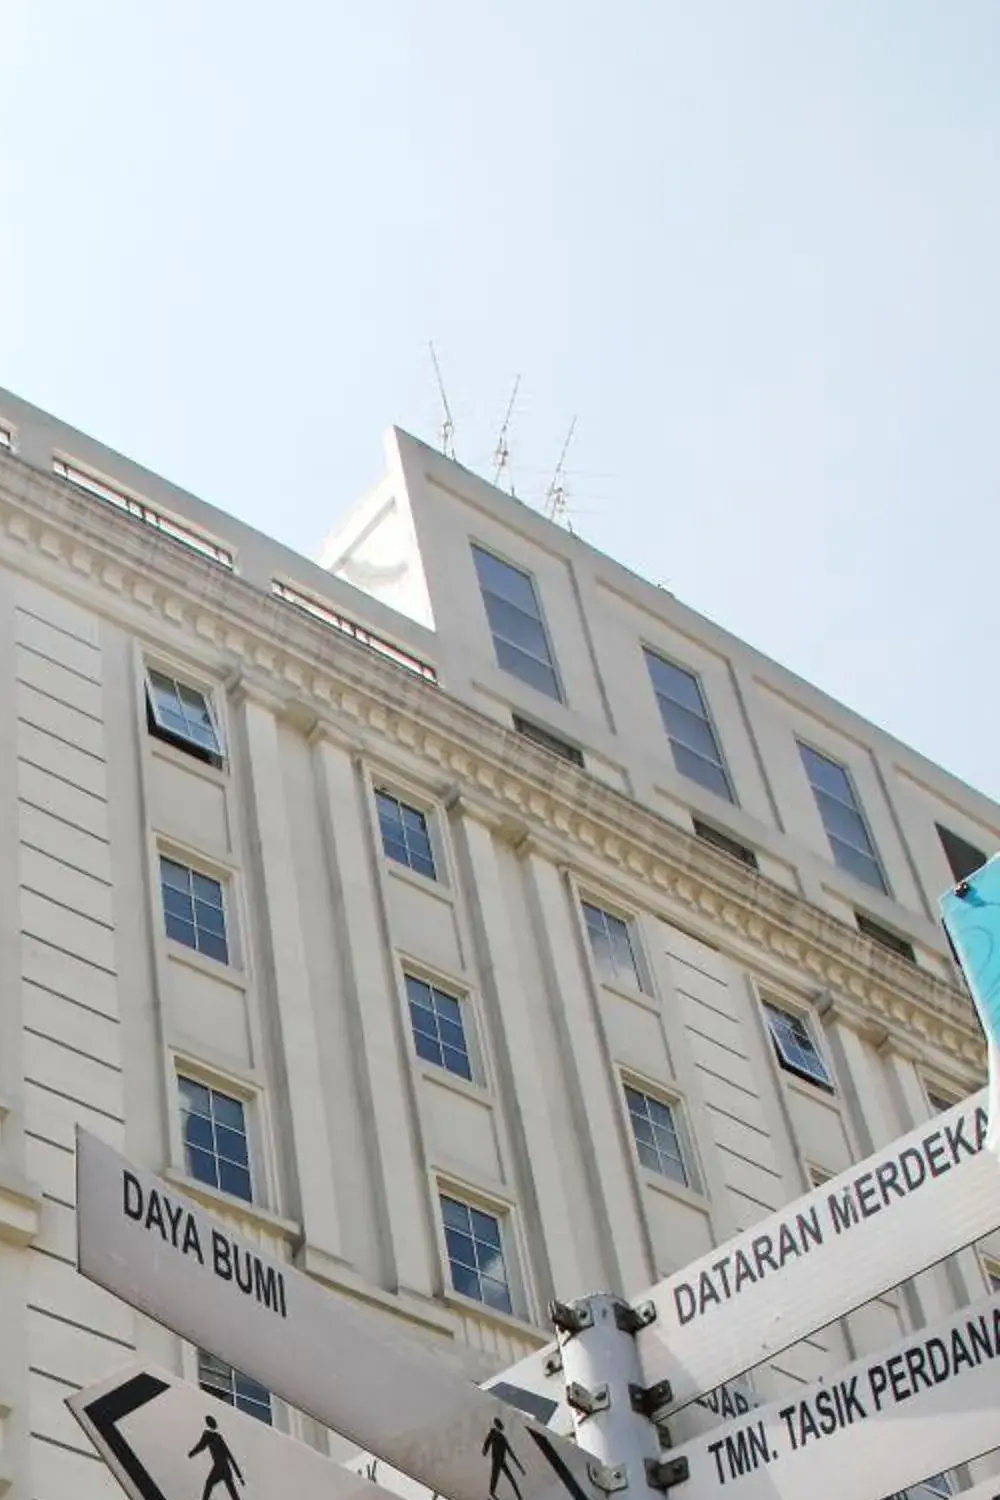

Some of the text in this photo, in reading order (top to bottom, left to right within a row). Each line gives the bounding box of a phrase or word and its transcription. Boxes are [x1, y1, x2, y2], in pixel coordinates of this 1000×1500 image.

[123, 1169, 287, 1319] DAYA BUMI
[674, 1206, 823, 1326] DATARAN
[708, 1420, 778, 1484] TMN.
[779, 1376, 867, 1450] TASIK
